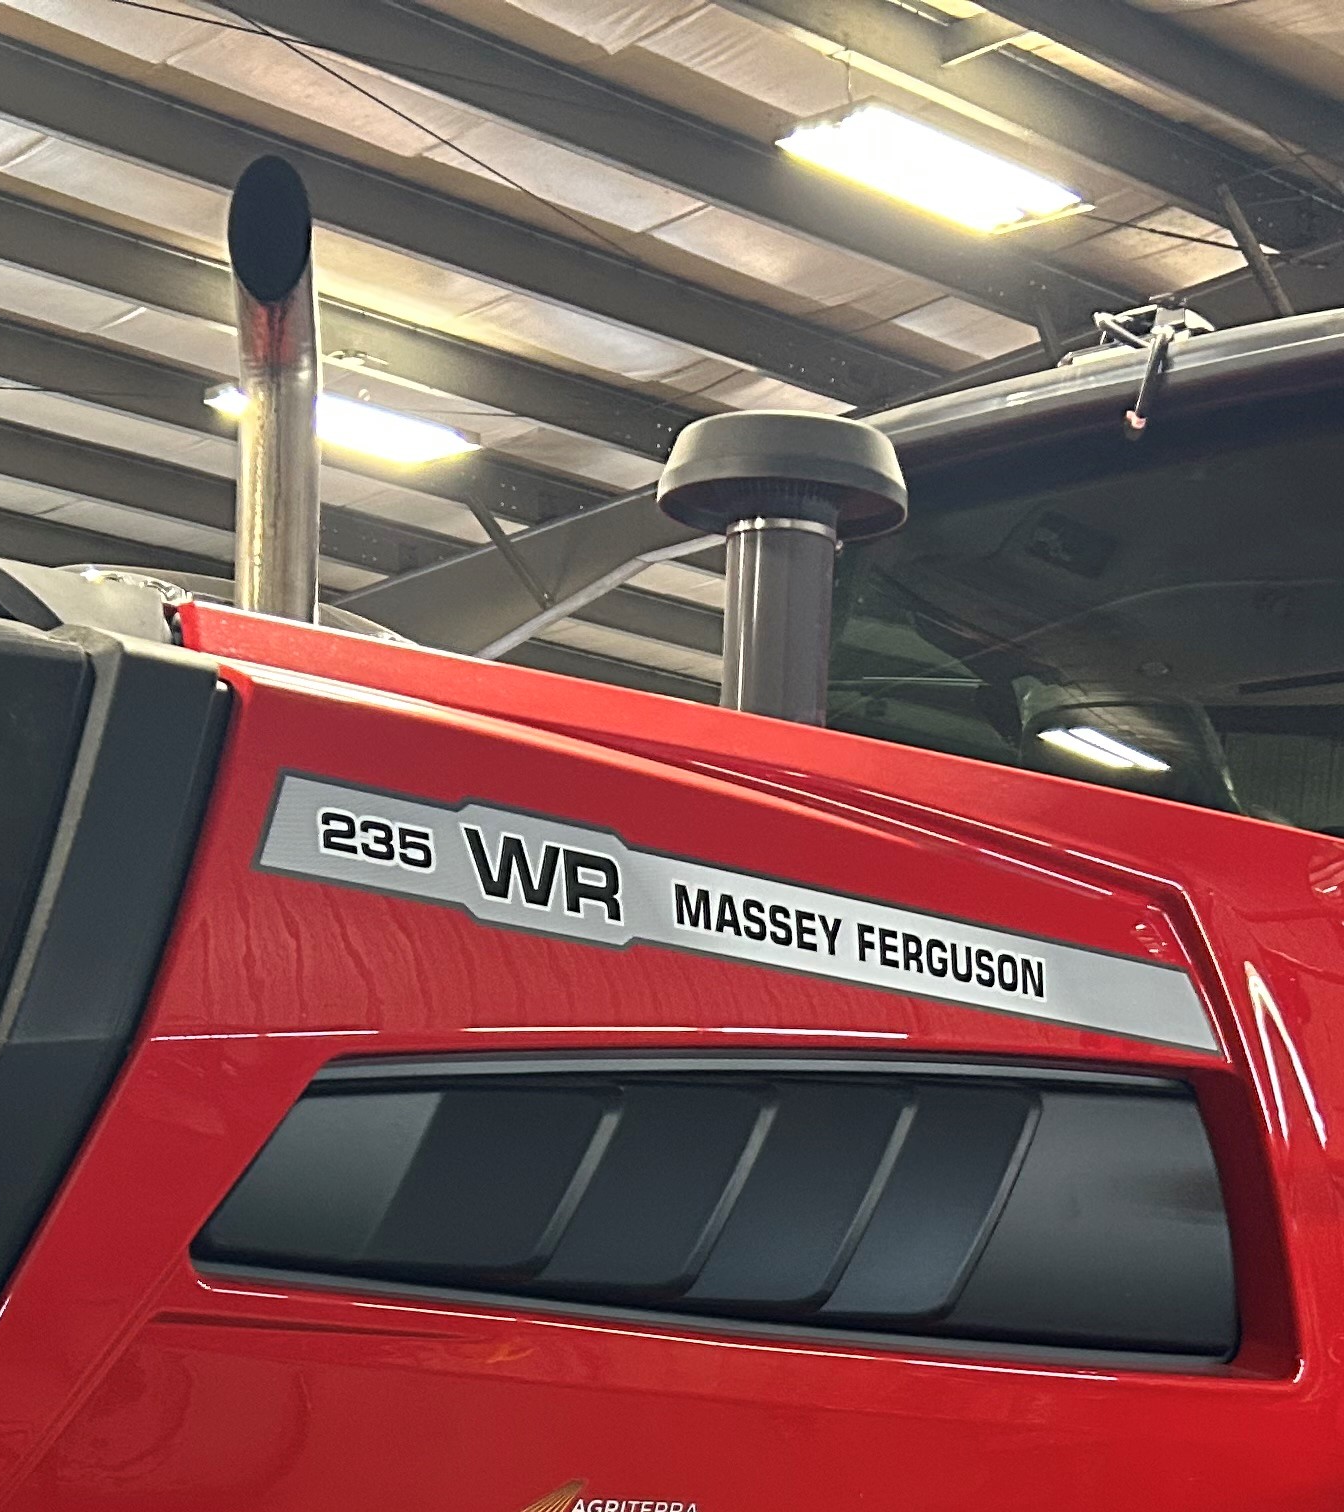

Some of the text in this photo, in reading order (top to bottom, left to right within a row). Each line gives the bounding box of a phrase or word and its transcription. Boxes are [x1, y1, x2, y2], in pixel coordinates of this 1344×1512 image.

[318, 808, 1046, 999] 235 WR MASSEY FERGUSON
